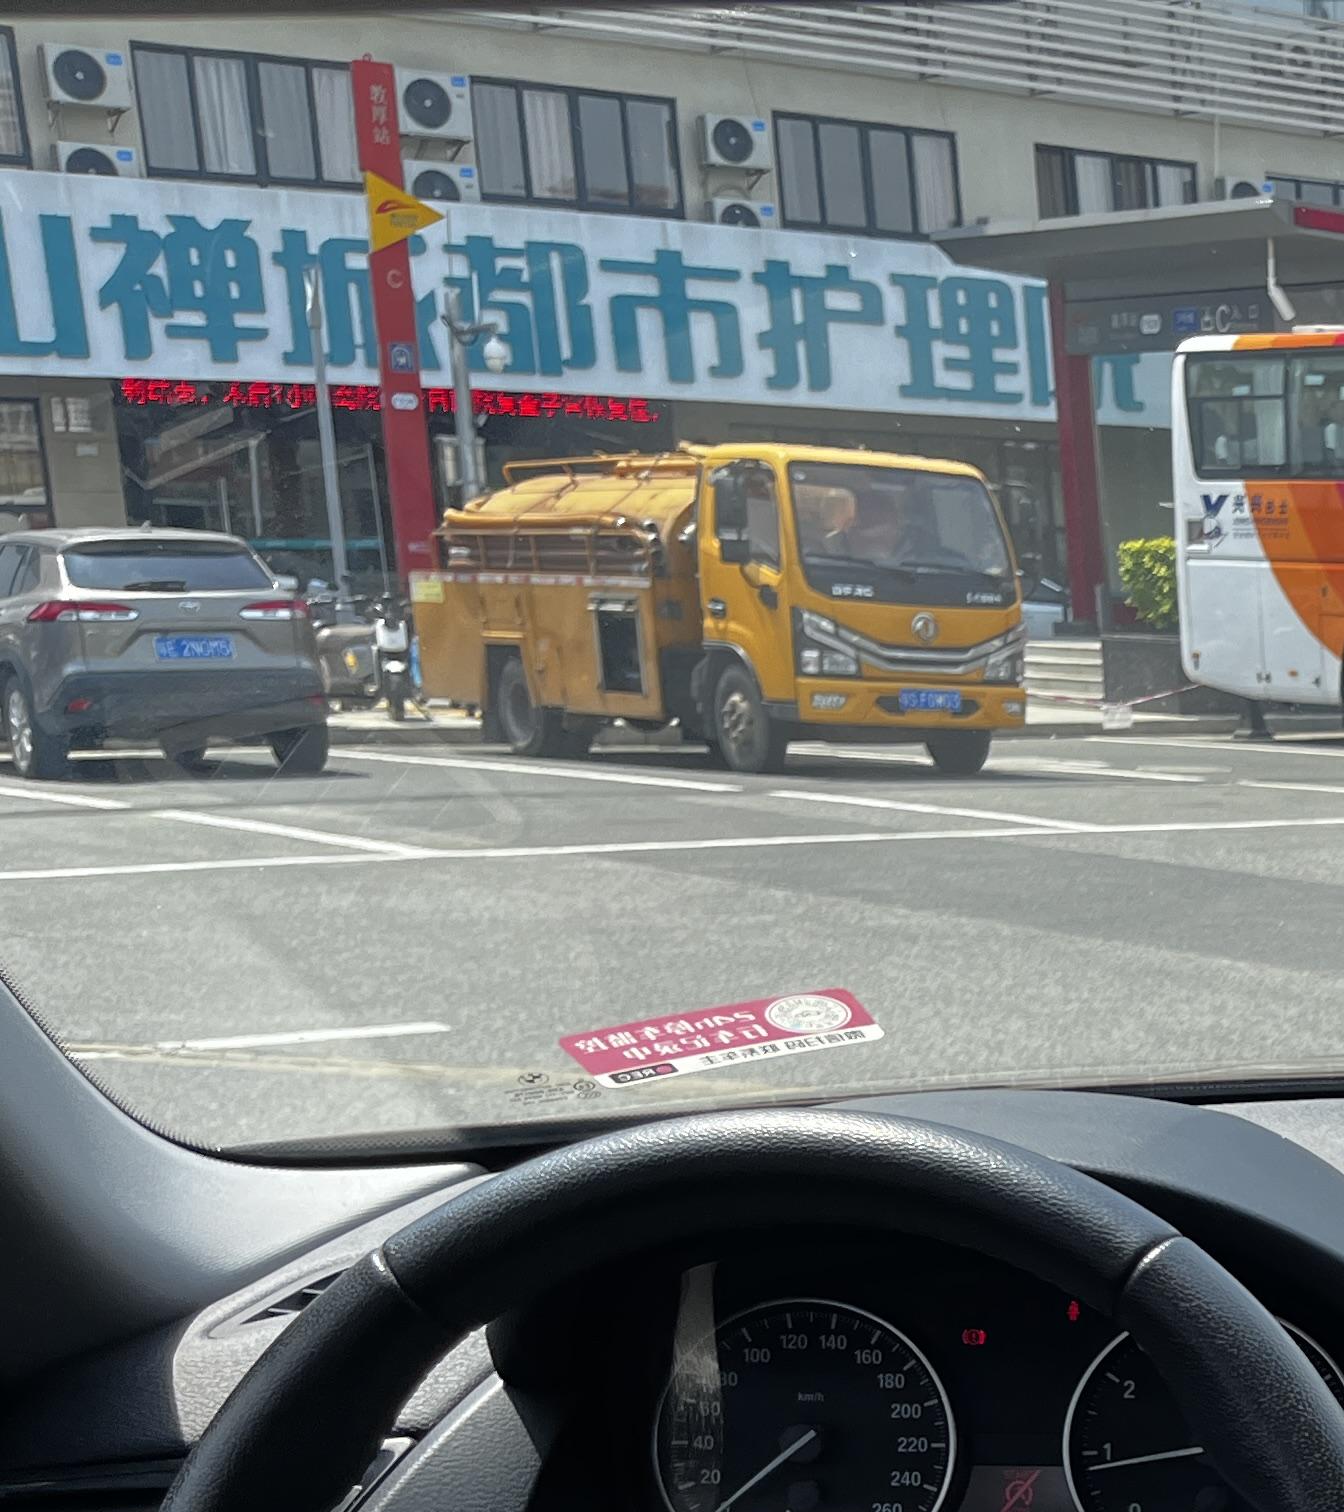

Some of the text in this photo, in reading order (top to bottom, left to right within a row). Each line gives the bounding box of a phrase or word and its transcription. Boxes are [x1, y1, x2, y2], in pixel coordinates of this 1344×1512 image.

[779, 1334, 808, 1350] 120
[819, 1335, 848, 1351] 140
[743, 1348, 771, 1364] 100
[854, 1350, 882, 1365] 160
[877, 1373, 905, 1389] 180
[1123, 1379, 1136, 1399] 2
[797, 1391, 825, 1402] km/h
[891, 1403, 922, 1420] 200
[693, 1435, 715, 1451] 40
[897, 1437, 928, 1453] 220
[1103, 1442, 1112, 1461] 1
[700, 1469, 721, 1485] 20
[890, 1471, 922, 1487] 240
